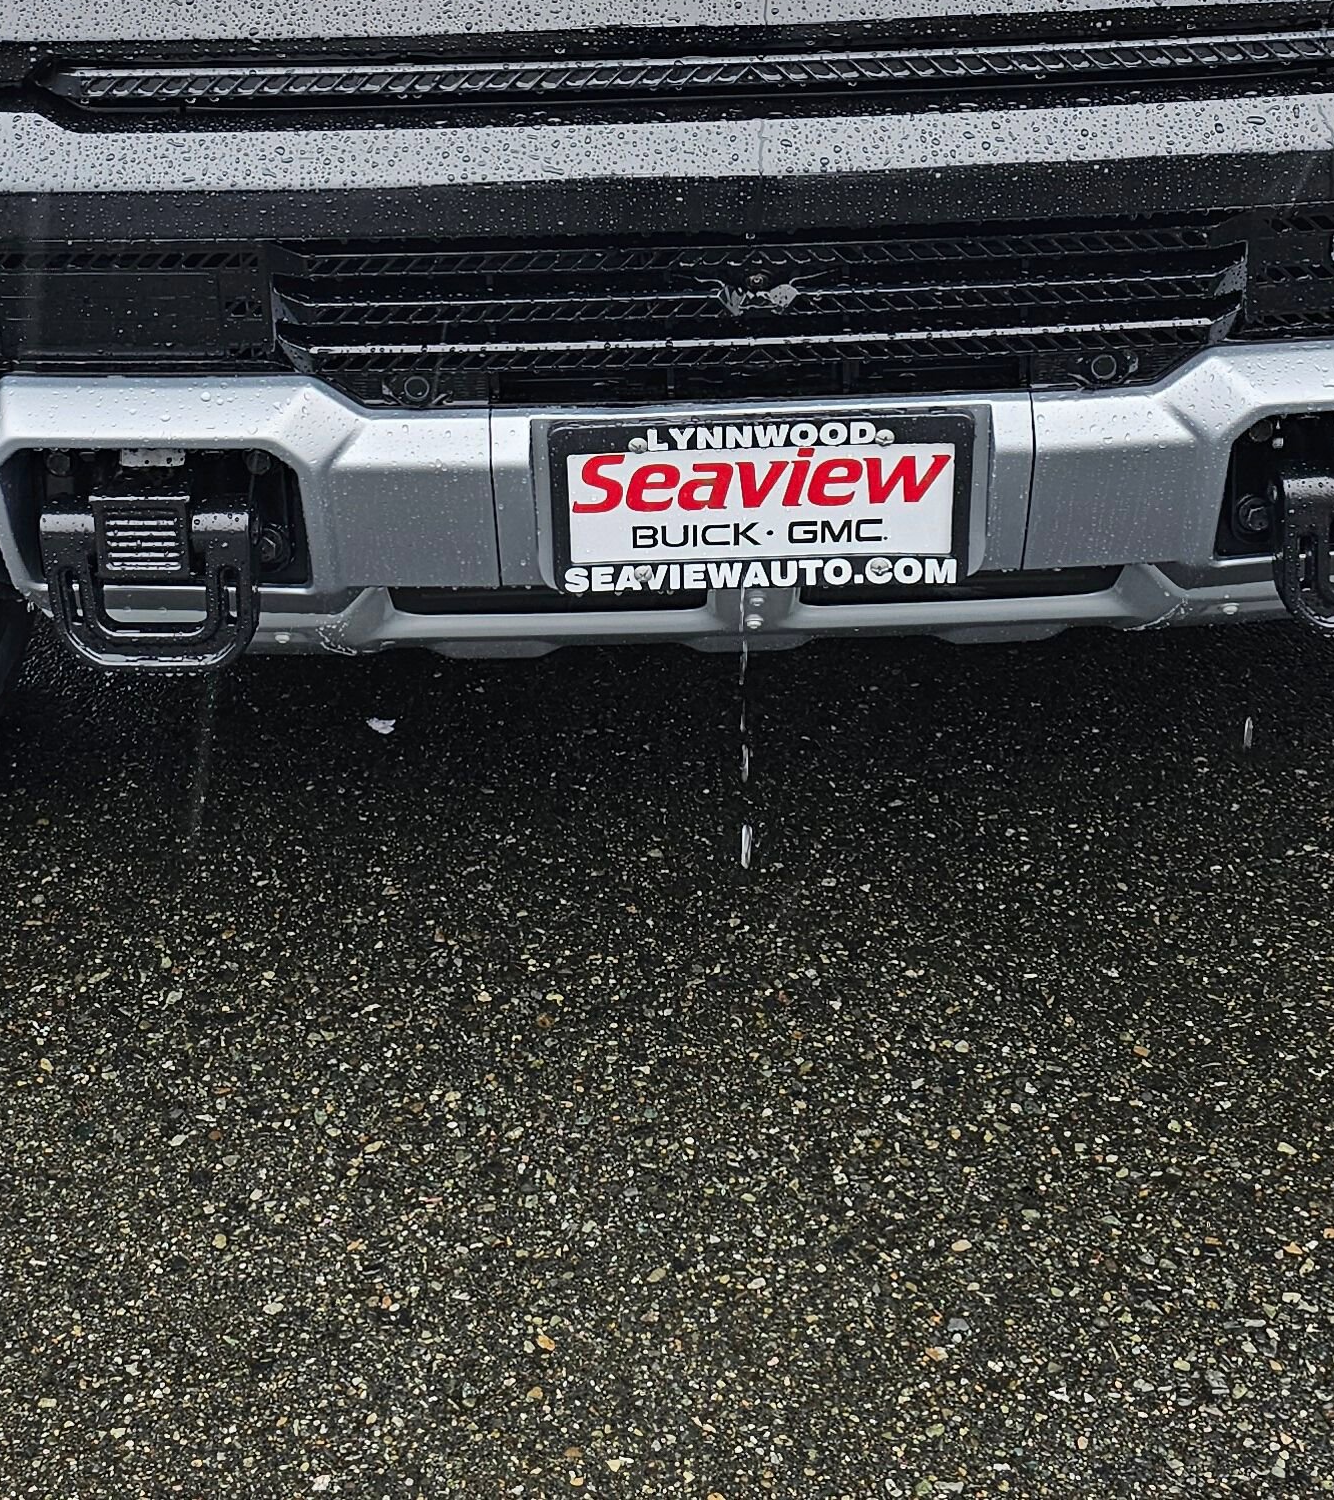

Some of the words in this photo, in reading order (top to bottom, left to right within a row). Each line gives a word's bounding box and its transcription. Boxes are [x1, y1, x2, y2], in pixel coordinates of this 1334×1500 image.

[646, 421, 877, 452] LYNNWOOD
[571, 446, 953, 514] Seaview
[631, 521, 762, 549] BUICK
[787, 518, 883, 544] GMC
[564, 557, 958, 594] SEAVIEWAUTO.COM
